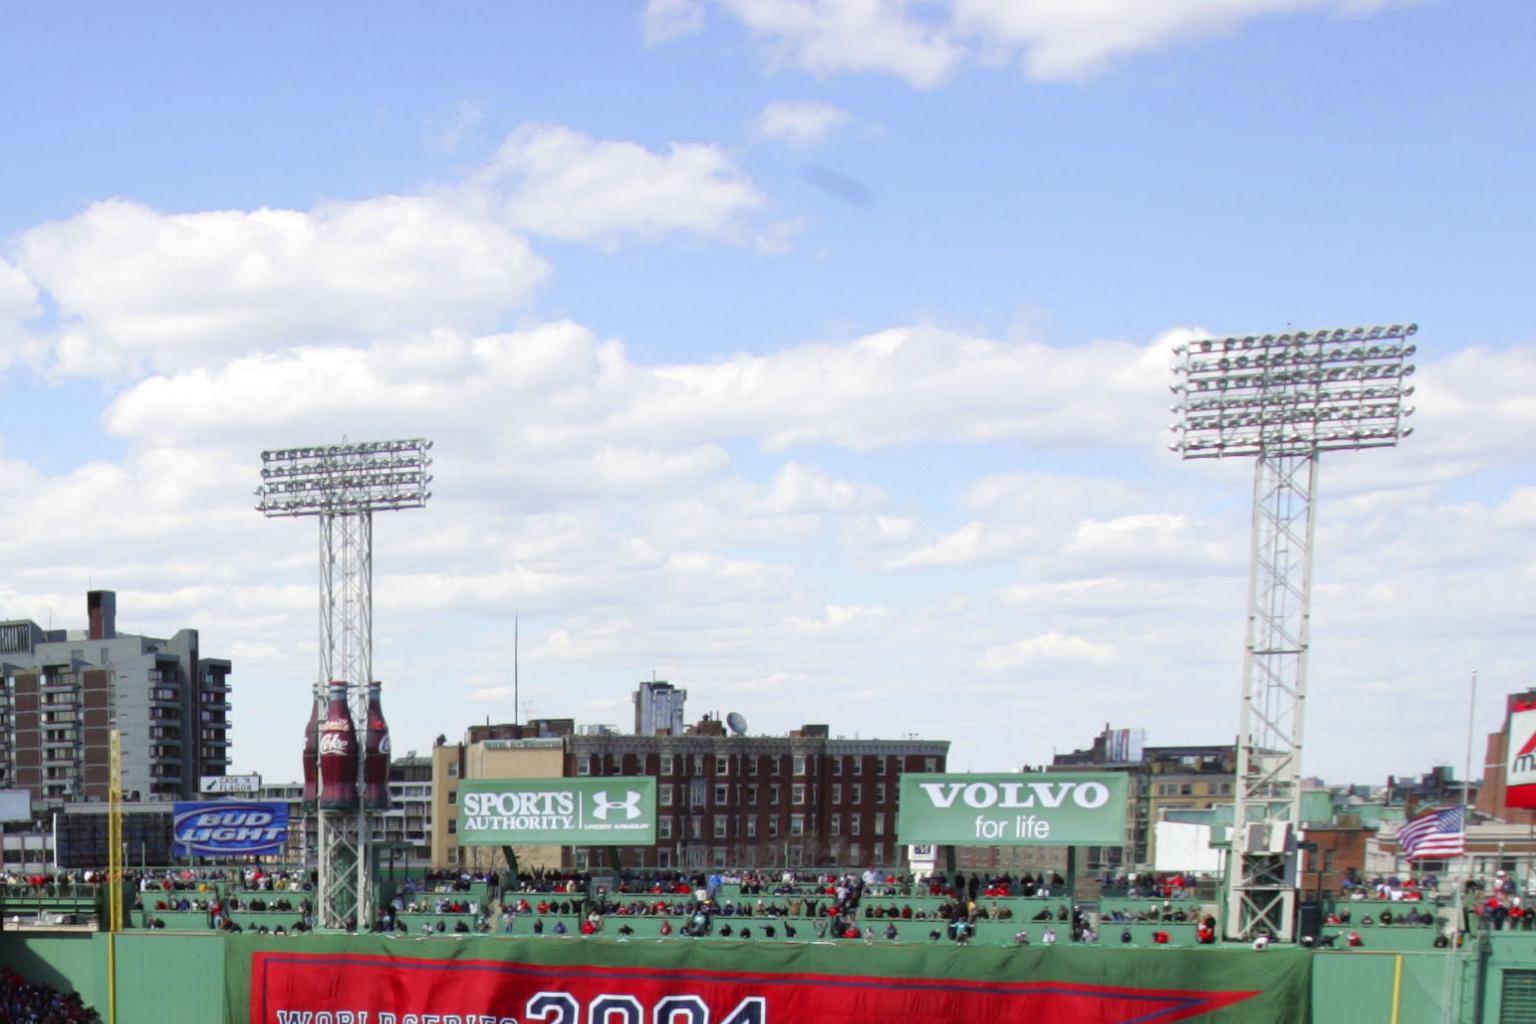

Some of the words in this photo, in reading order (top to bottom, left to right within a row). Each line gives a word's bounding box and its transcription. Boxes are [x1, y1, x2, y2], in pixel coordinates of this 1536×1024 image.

[320, 731, 349, 756] Coke
[464, 791, 574, 816] SPORTS
[919, 781, 1110, 809] VOLVO
[196, 812, 272, 827] BUD
[464, 815, 573, 830] AUTHORITY
[974, 814, 1008, 838] for
[1016, 814, 1050, 838] life
[182, 827, 286, 841] LIGHT
